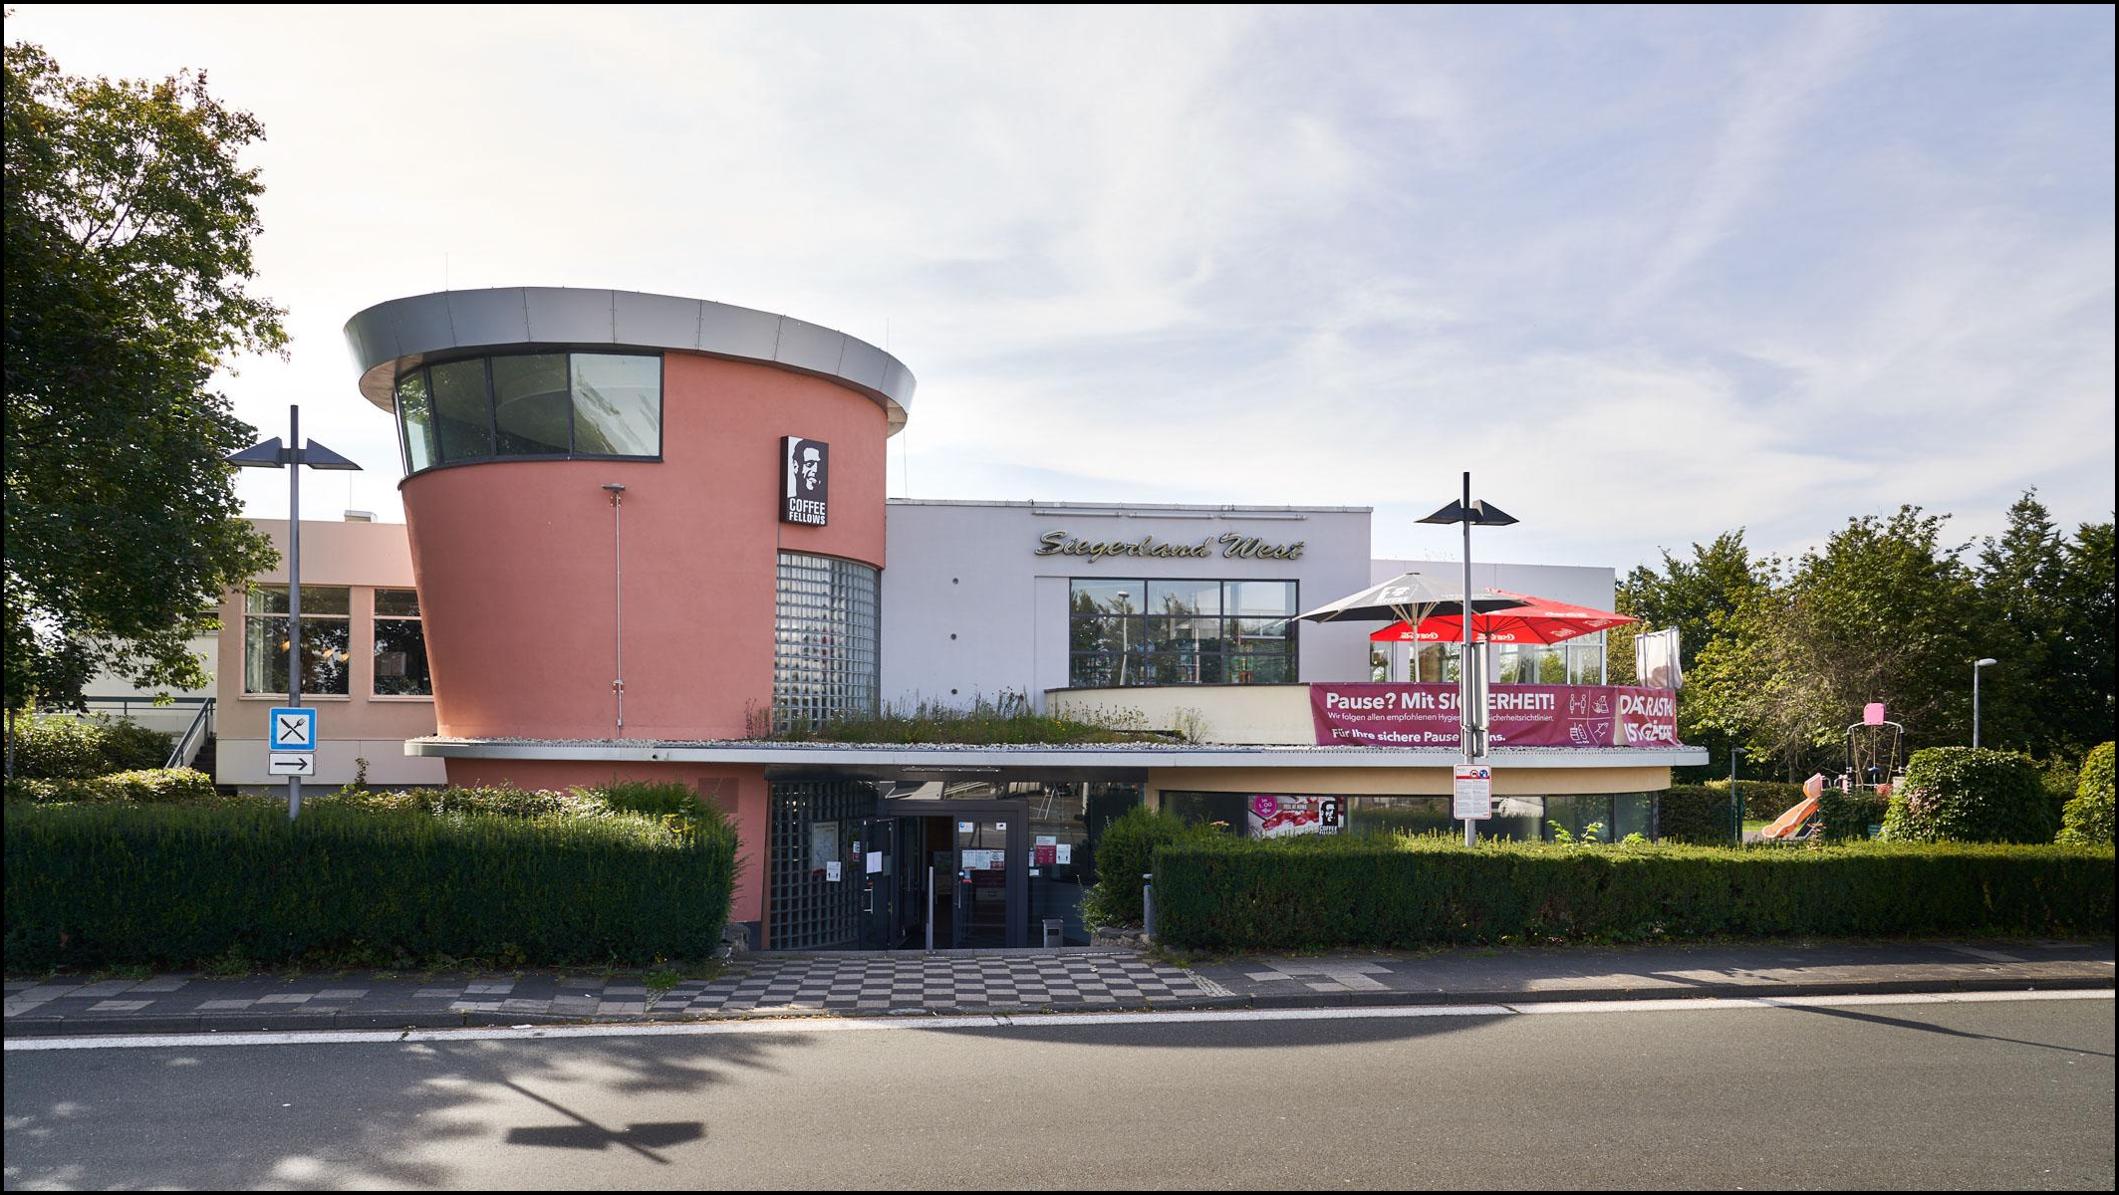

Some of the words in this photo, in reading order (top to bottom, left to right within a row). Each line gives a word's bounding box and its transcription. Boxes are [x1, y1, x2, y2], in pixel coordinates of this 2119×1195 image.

[789, 498, 826, 516] COFFEE
[789, 511, 826, 525] FELLOWS
[1035, 530, 1215, 563] Siegerland
[1218, 531, 1304, 561] West
[1326, 692, 1397, 710] Pause?
[1401, 692, 1435, 710] Mit
[1438, 692, 1555, 710] SIERHEIT!
[1328, 711, 1341, 719] Wir
[1342, 712, 1366, 723] folgen
[1366, 713, 1386, 721] allen
[1386, 713, 1437, 722] empfohlenen
[1331, 728, 1350, 739] Für
[1352, 728, 1376, 740] Ihre
[1377, 731, 1422, 742] sichere
[1423, 731, 1460, 743] Pause
[1489, 734, 1507, 743] ns.
